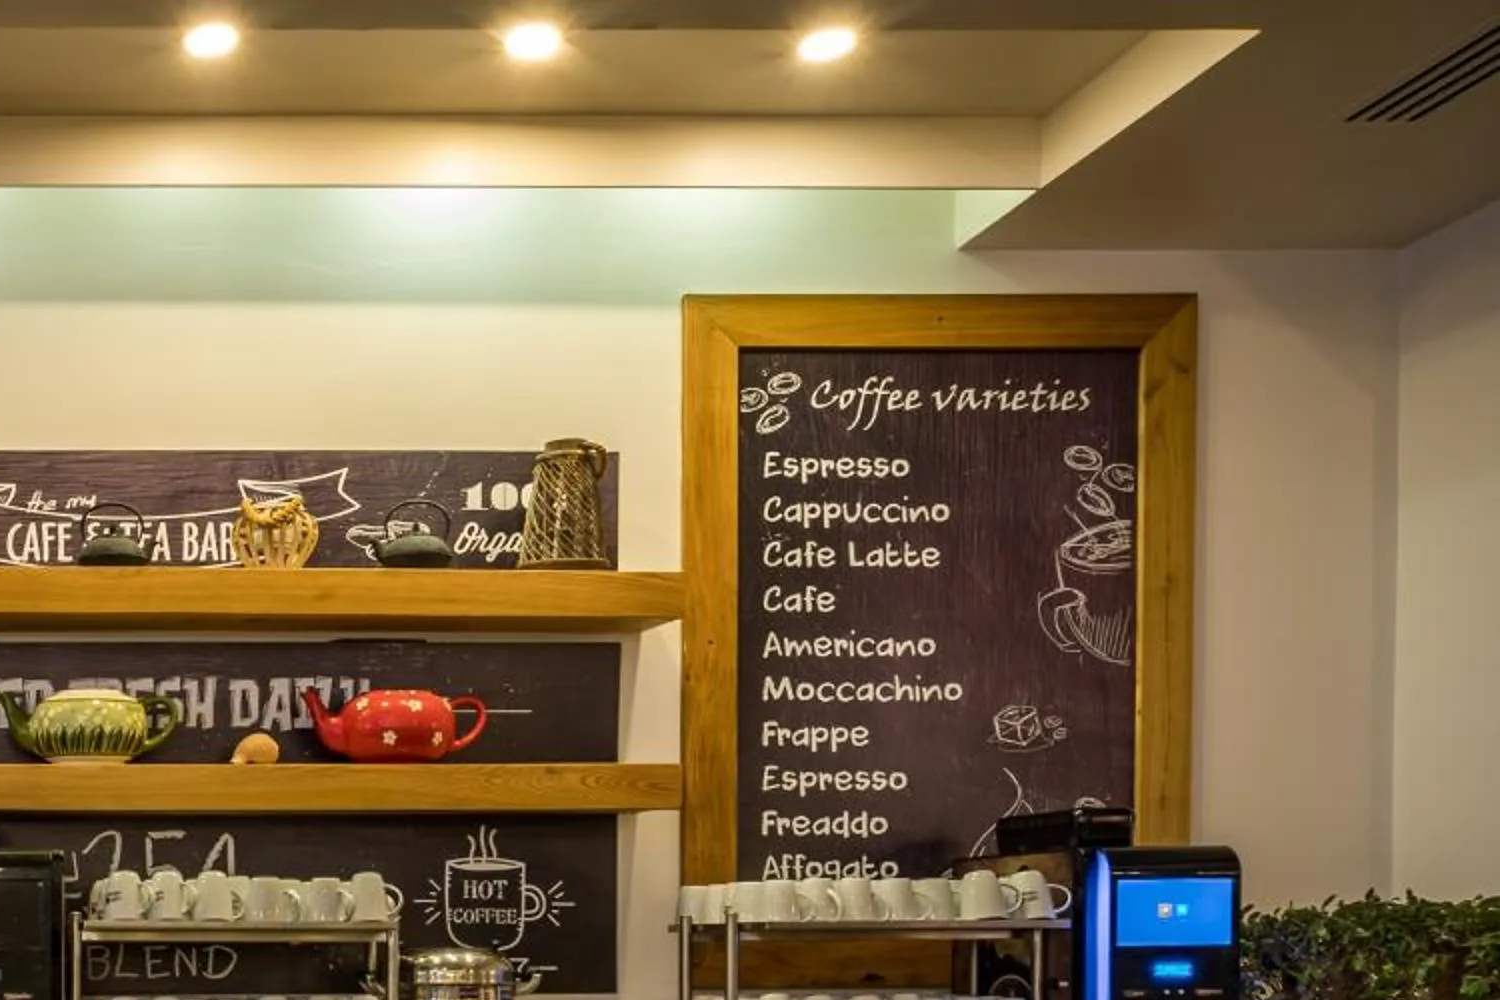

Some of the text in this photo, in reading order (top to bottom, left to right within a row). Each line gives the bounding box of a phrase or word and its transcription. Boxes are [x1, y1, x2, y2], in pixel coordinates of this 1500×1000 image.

[810, 375, 1090, 431] Coffee varieties
[763, 451, 910, 484] Espresso
[763, 495, 951, 529] Cappuccino
[6, 521, 74, 562] CAFE
[182, 521, 238, 562] BAR
[763, 540, 941, 568] Cafe Latte
[763, 585, 836, 613] Cafe
[762, 629, 937, 659] Americano
[762, 674, 963, 703] Moccachino
[762, 720, 869, 753] Frappe
[762, 765, 908, 798] Espresso
[761, 810, 889, 839] Freaddo
[463, 879, 508, 899] HOT
[453, 907, 517, 925] COFFEE
[86, 944, 238, 980] BLEND
